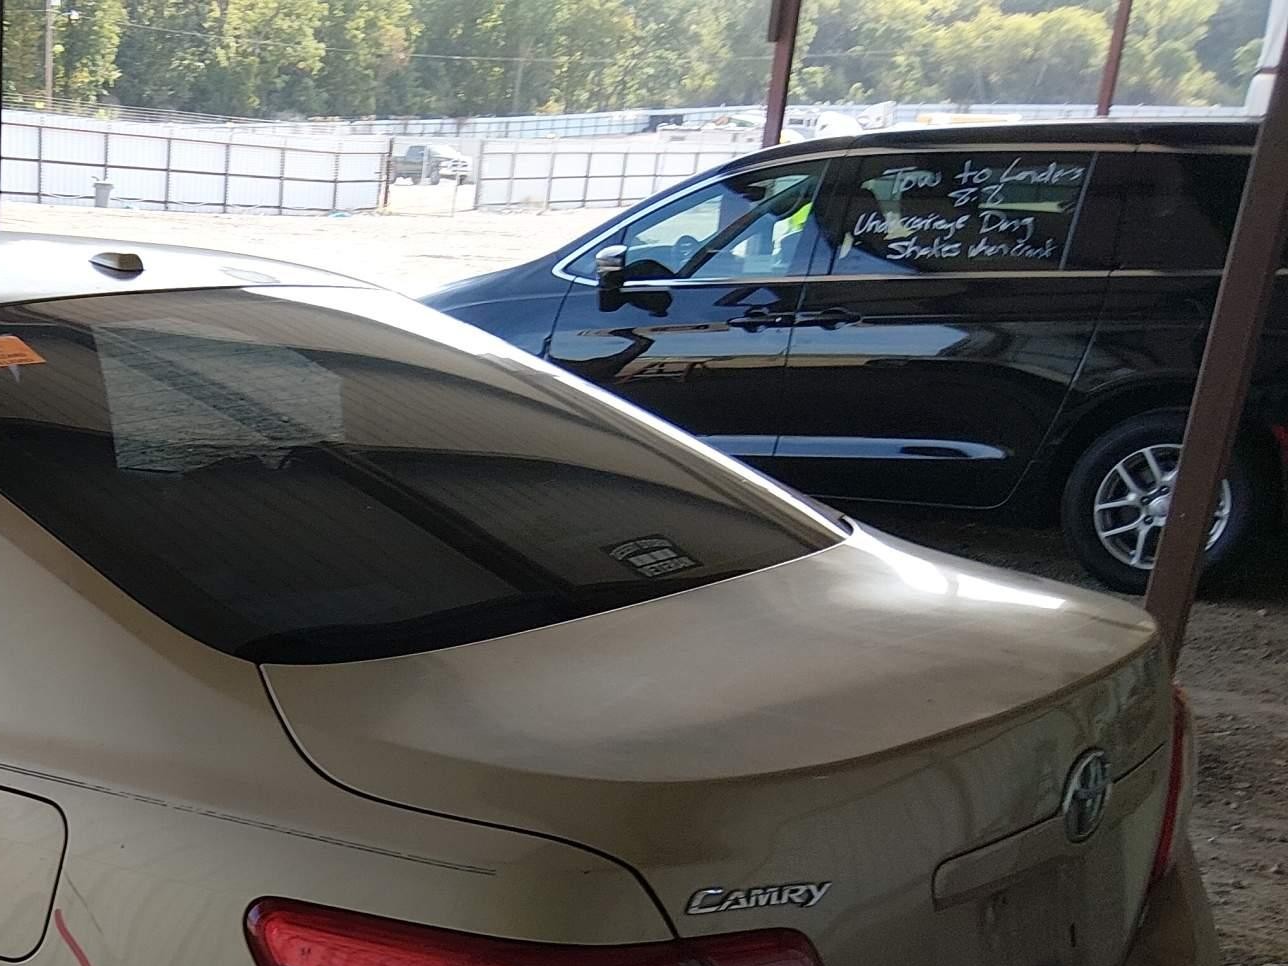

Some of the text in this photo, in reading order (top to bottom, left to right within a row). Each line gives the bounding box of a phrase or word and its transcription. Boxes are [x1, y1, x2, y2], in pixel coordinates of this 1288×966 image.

[883, 166, 942, 194] Tow
[954, 159, 992, 186] to
[686, 881, 833, 915] CAMRY
